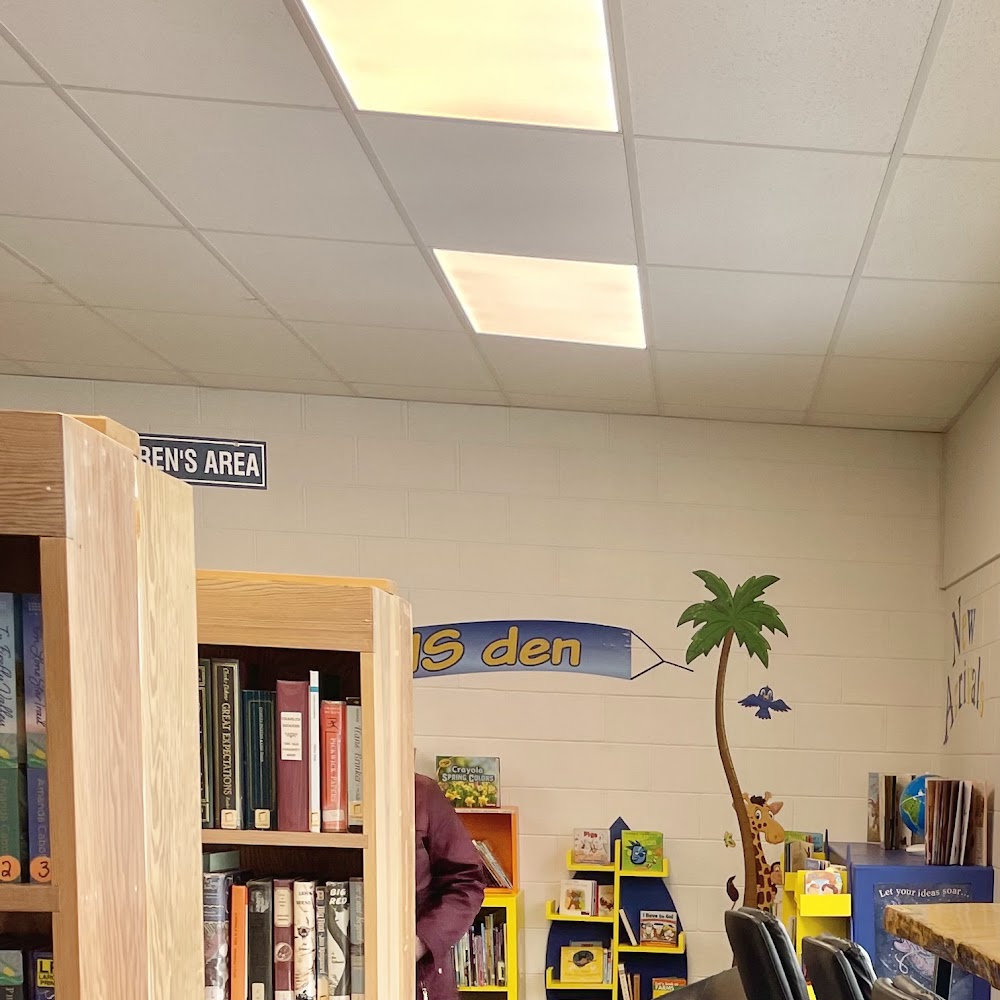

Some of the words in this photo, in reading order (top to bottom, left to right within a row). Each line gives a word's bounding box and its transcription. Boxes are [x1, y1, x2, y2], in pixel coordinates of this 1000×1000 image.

[204, 450, 260, 477] AREA
[481, 625, 582, 667] den
[221, 703, 231, 731] GREAT
[222, 733, 233, 796] EXPECTATIONS
[452, 765, 484, 774] Crayola
[442, 773, 467, 782] SPRING
[468, 774, 494, 782] COLORS
[37, 778, 45, 823] Amanda
[583, 831, 598, 839] Pigs
[1, 860, 11, 877] 2
[38, 861, 50, 878] 3
[329, 888, 347, 897] BIG
[879, 888, 893, 898] Let
[896, 888, 916, 897] your
[918, 888, 940, 897] ideas
[328, 897, 348, 906] RED
